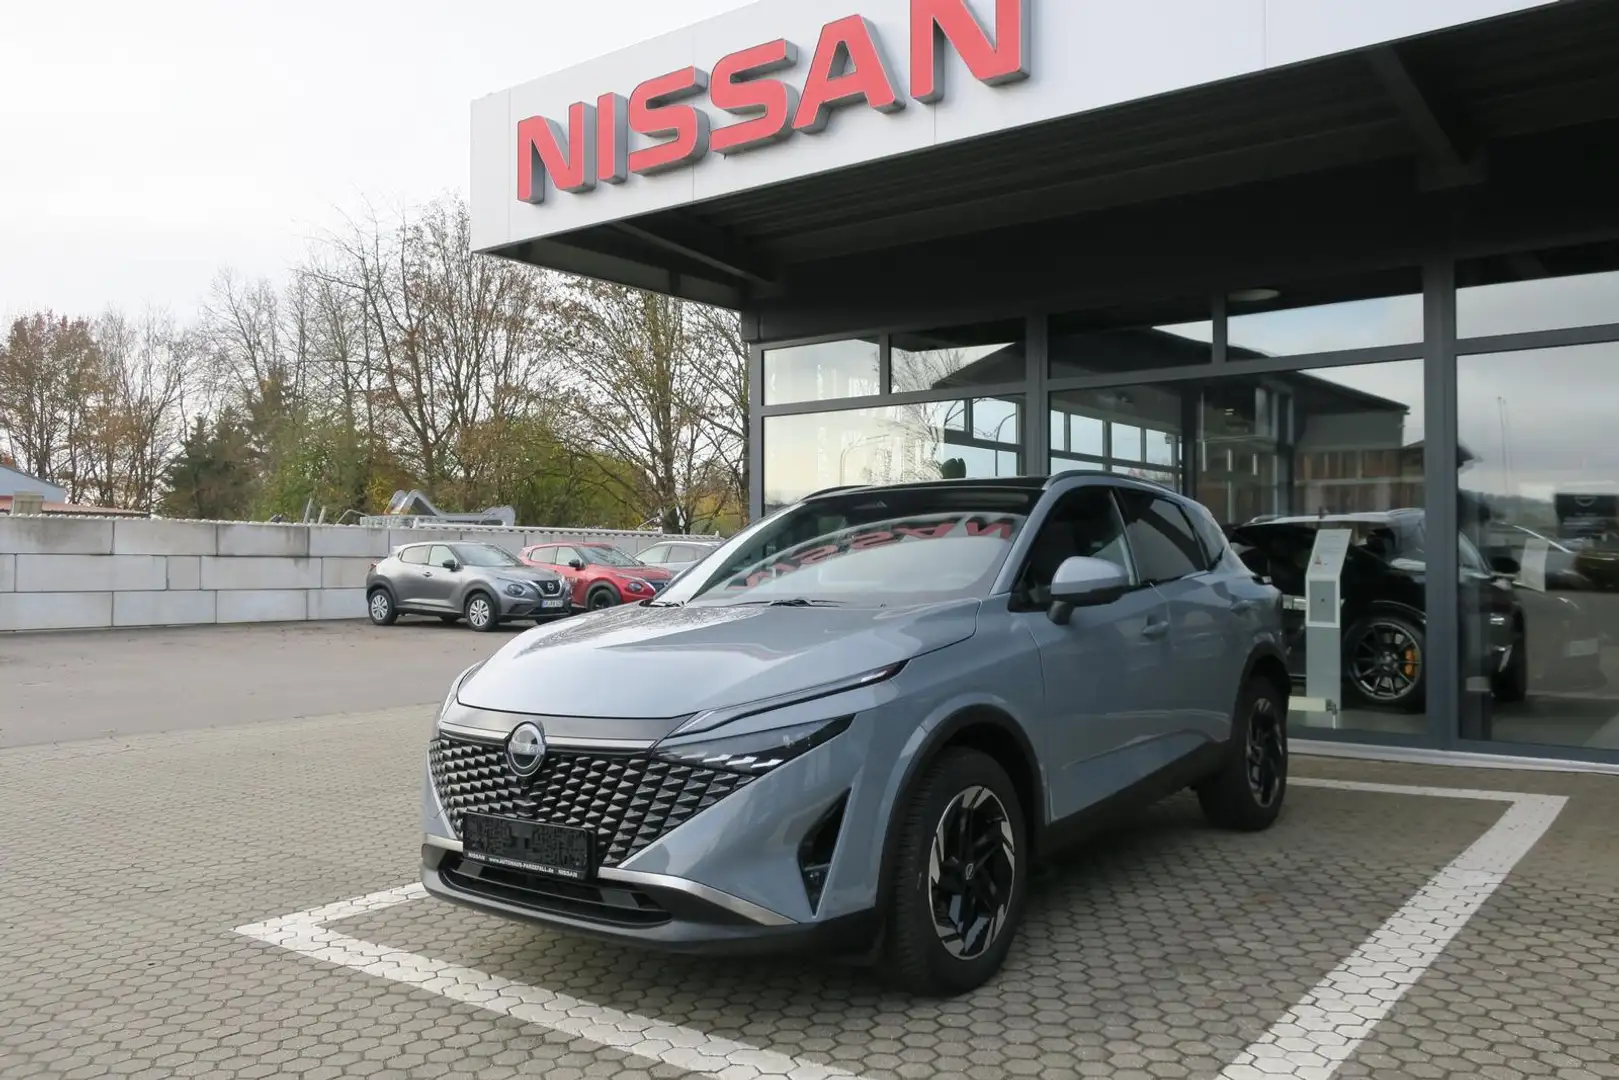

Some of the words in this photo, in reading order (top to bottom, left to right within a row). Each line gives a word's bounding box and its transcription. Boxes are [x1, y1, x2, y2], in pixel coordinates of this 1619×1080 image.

[517, 0, 1030, 204] NISSAN
[468, 851, 486, 860] NISSAN
[558, 869, 578, 878] NISSAN
